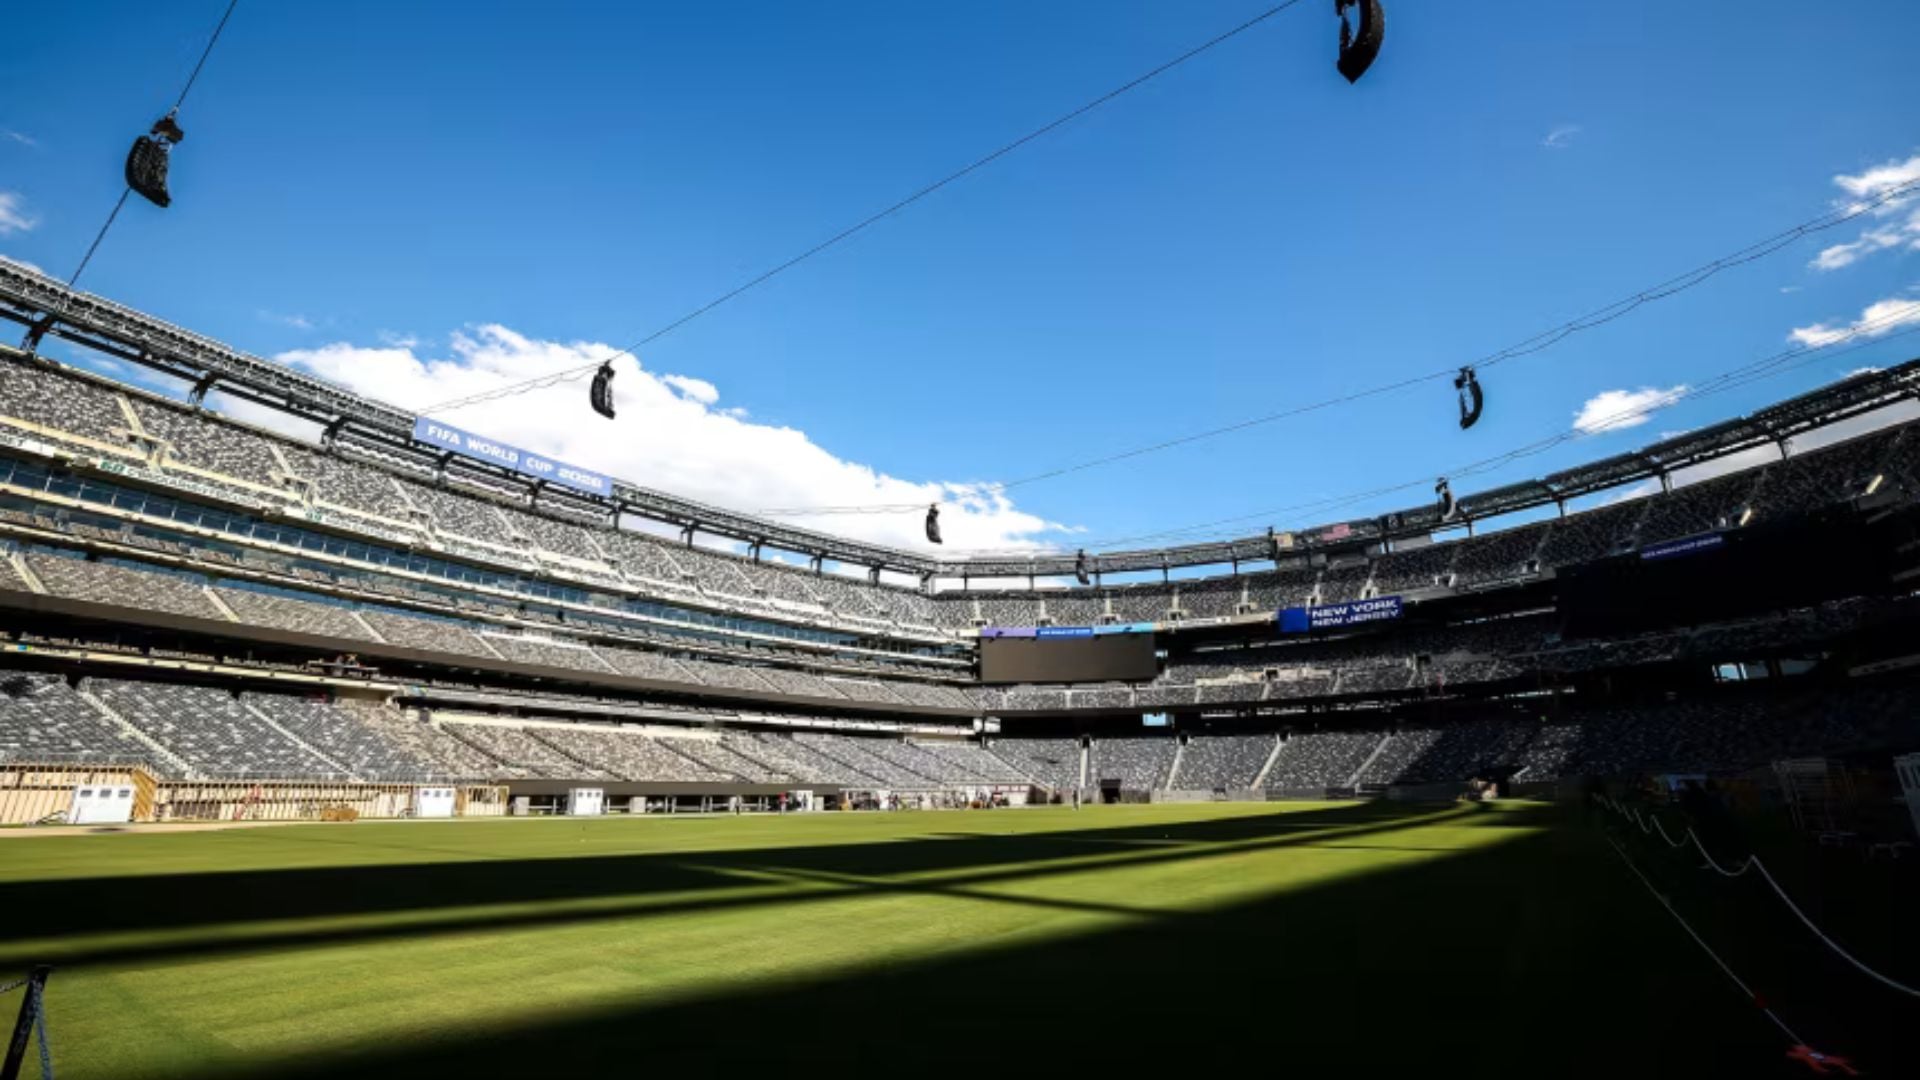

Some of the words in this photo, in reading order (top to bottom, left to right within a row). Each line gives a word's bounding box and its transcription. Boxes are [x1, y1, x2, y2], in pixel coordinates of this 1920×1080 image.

[427, 425, 461, 446] FIFA
[467, 438, 519, 463] WORLD
[526, 457, 554, 473] CUP
[1312, 606, 1348, 619] NEW
[1351, 600, 1398, 612] YORK
[1312, 617, 1342, 626] NEW
